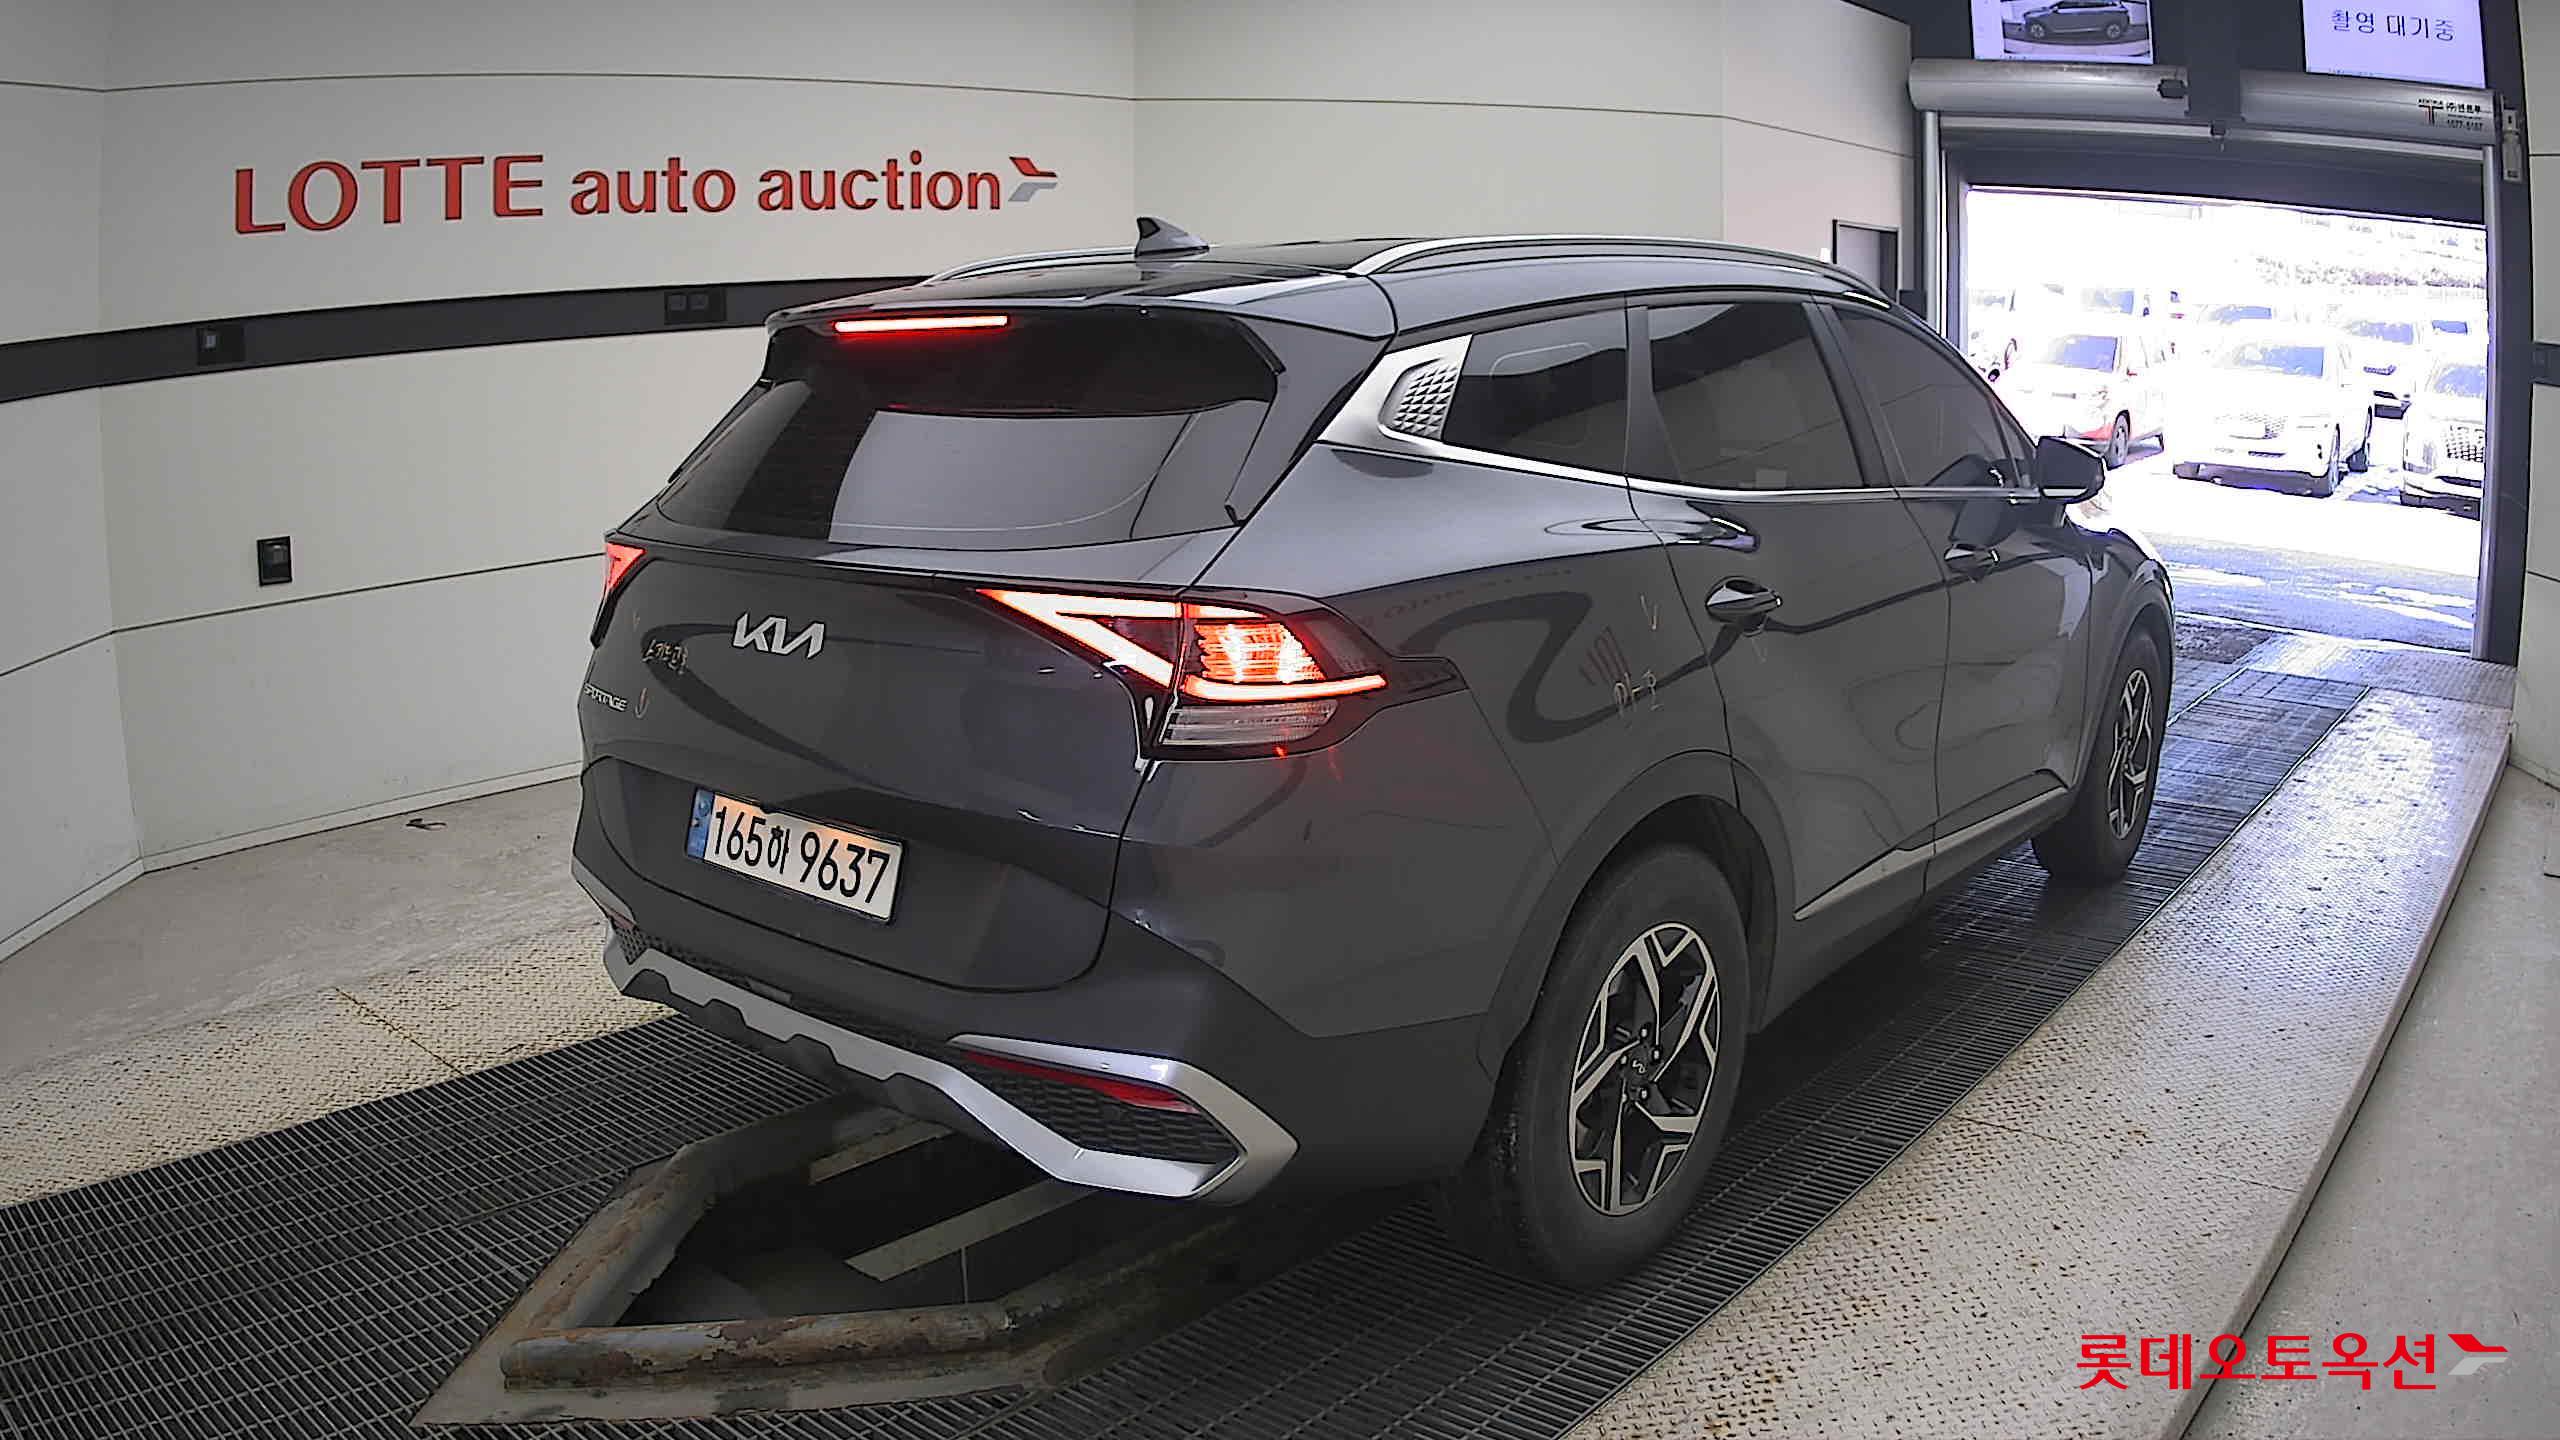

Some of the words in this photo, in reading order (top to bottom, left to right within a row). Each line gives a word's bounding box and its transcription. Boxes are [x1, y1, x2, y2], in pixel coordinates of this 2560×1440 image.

[2331, 9, 2376, 34] 촬영
[2386, 14, 2455, 42] 대기중
[235, 154, 543, 234] LOTTE
[569, 157, 737, 214] auto
[758, 150, 1001, 211] auction
[732, 612, 826, 659] KIA
[714, 805, 790, 874] 165하
[799, 831, 890, 904] 9637
